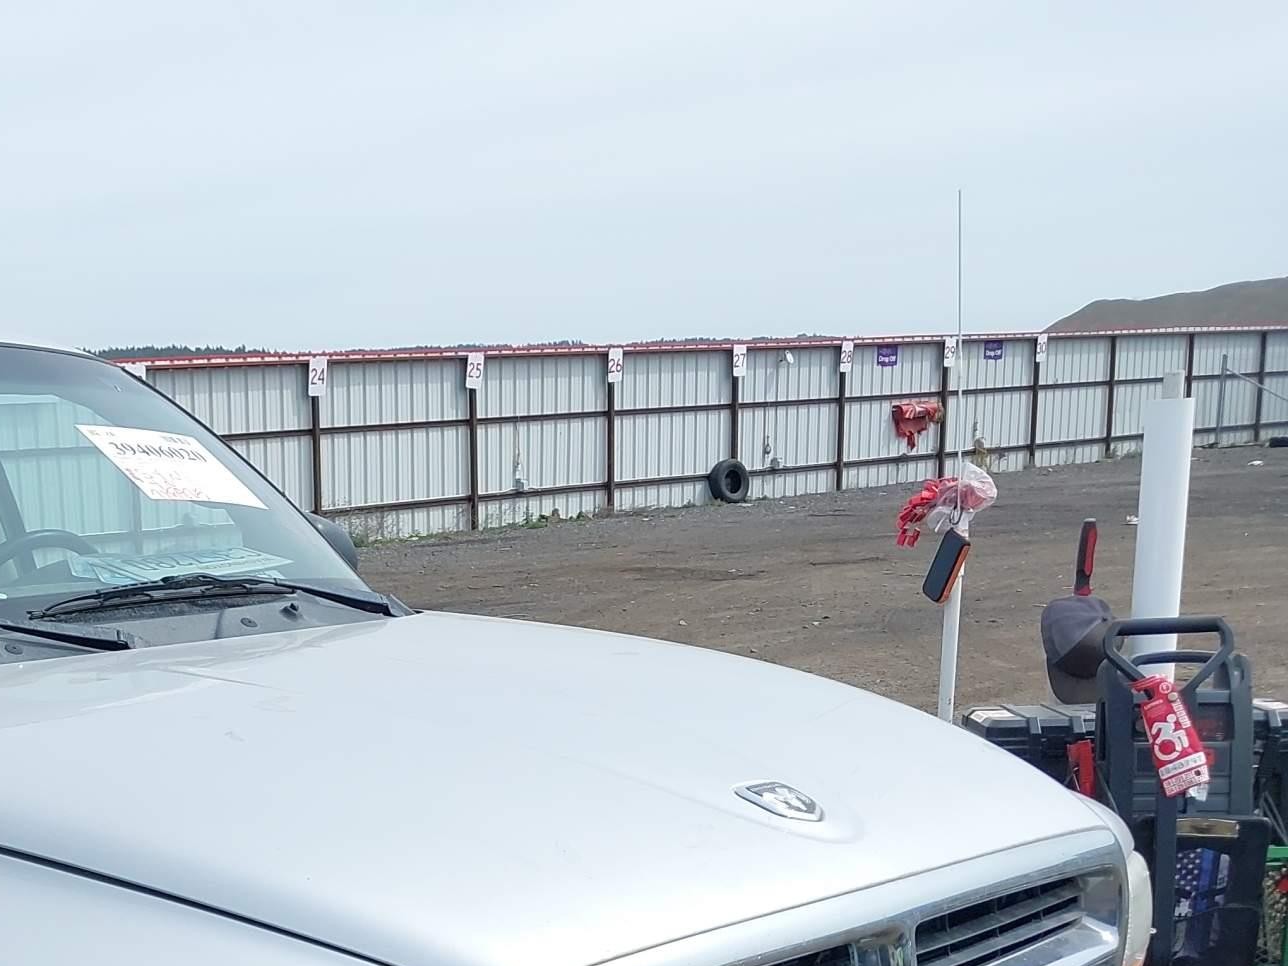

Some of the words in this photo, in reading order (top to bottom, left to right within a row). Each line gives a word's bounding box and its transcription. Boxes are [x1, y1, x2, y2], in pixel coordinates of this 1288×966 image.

[840, 350, 852, 364] 28
[944, 345, 956, 359] 29
[608, 358, 622, 373] 26
[734, 353, 746, 368] 27
[311, 367, 325, 385] 24
[468, 362, 482, 378] 25
[108, 441, 208, 463] 39406020
